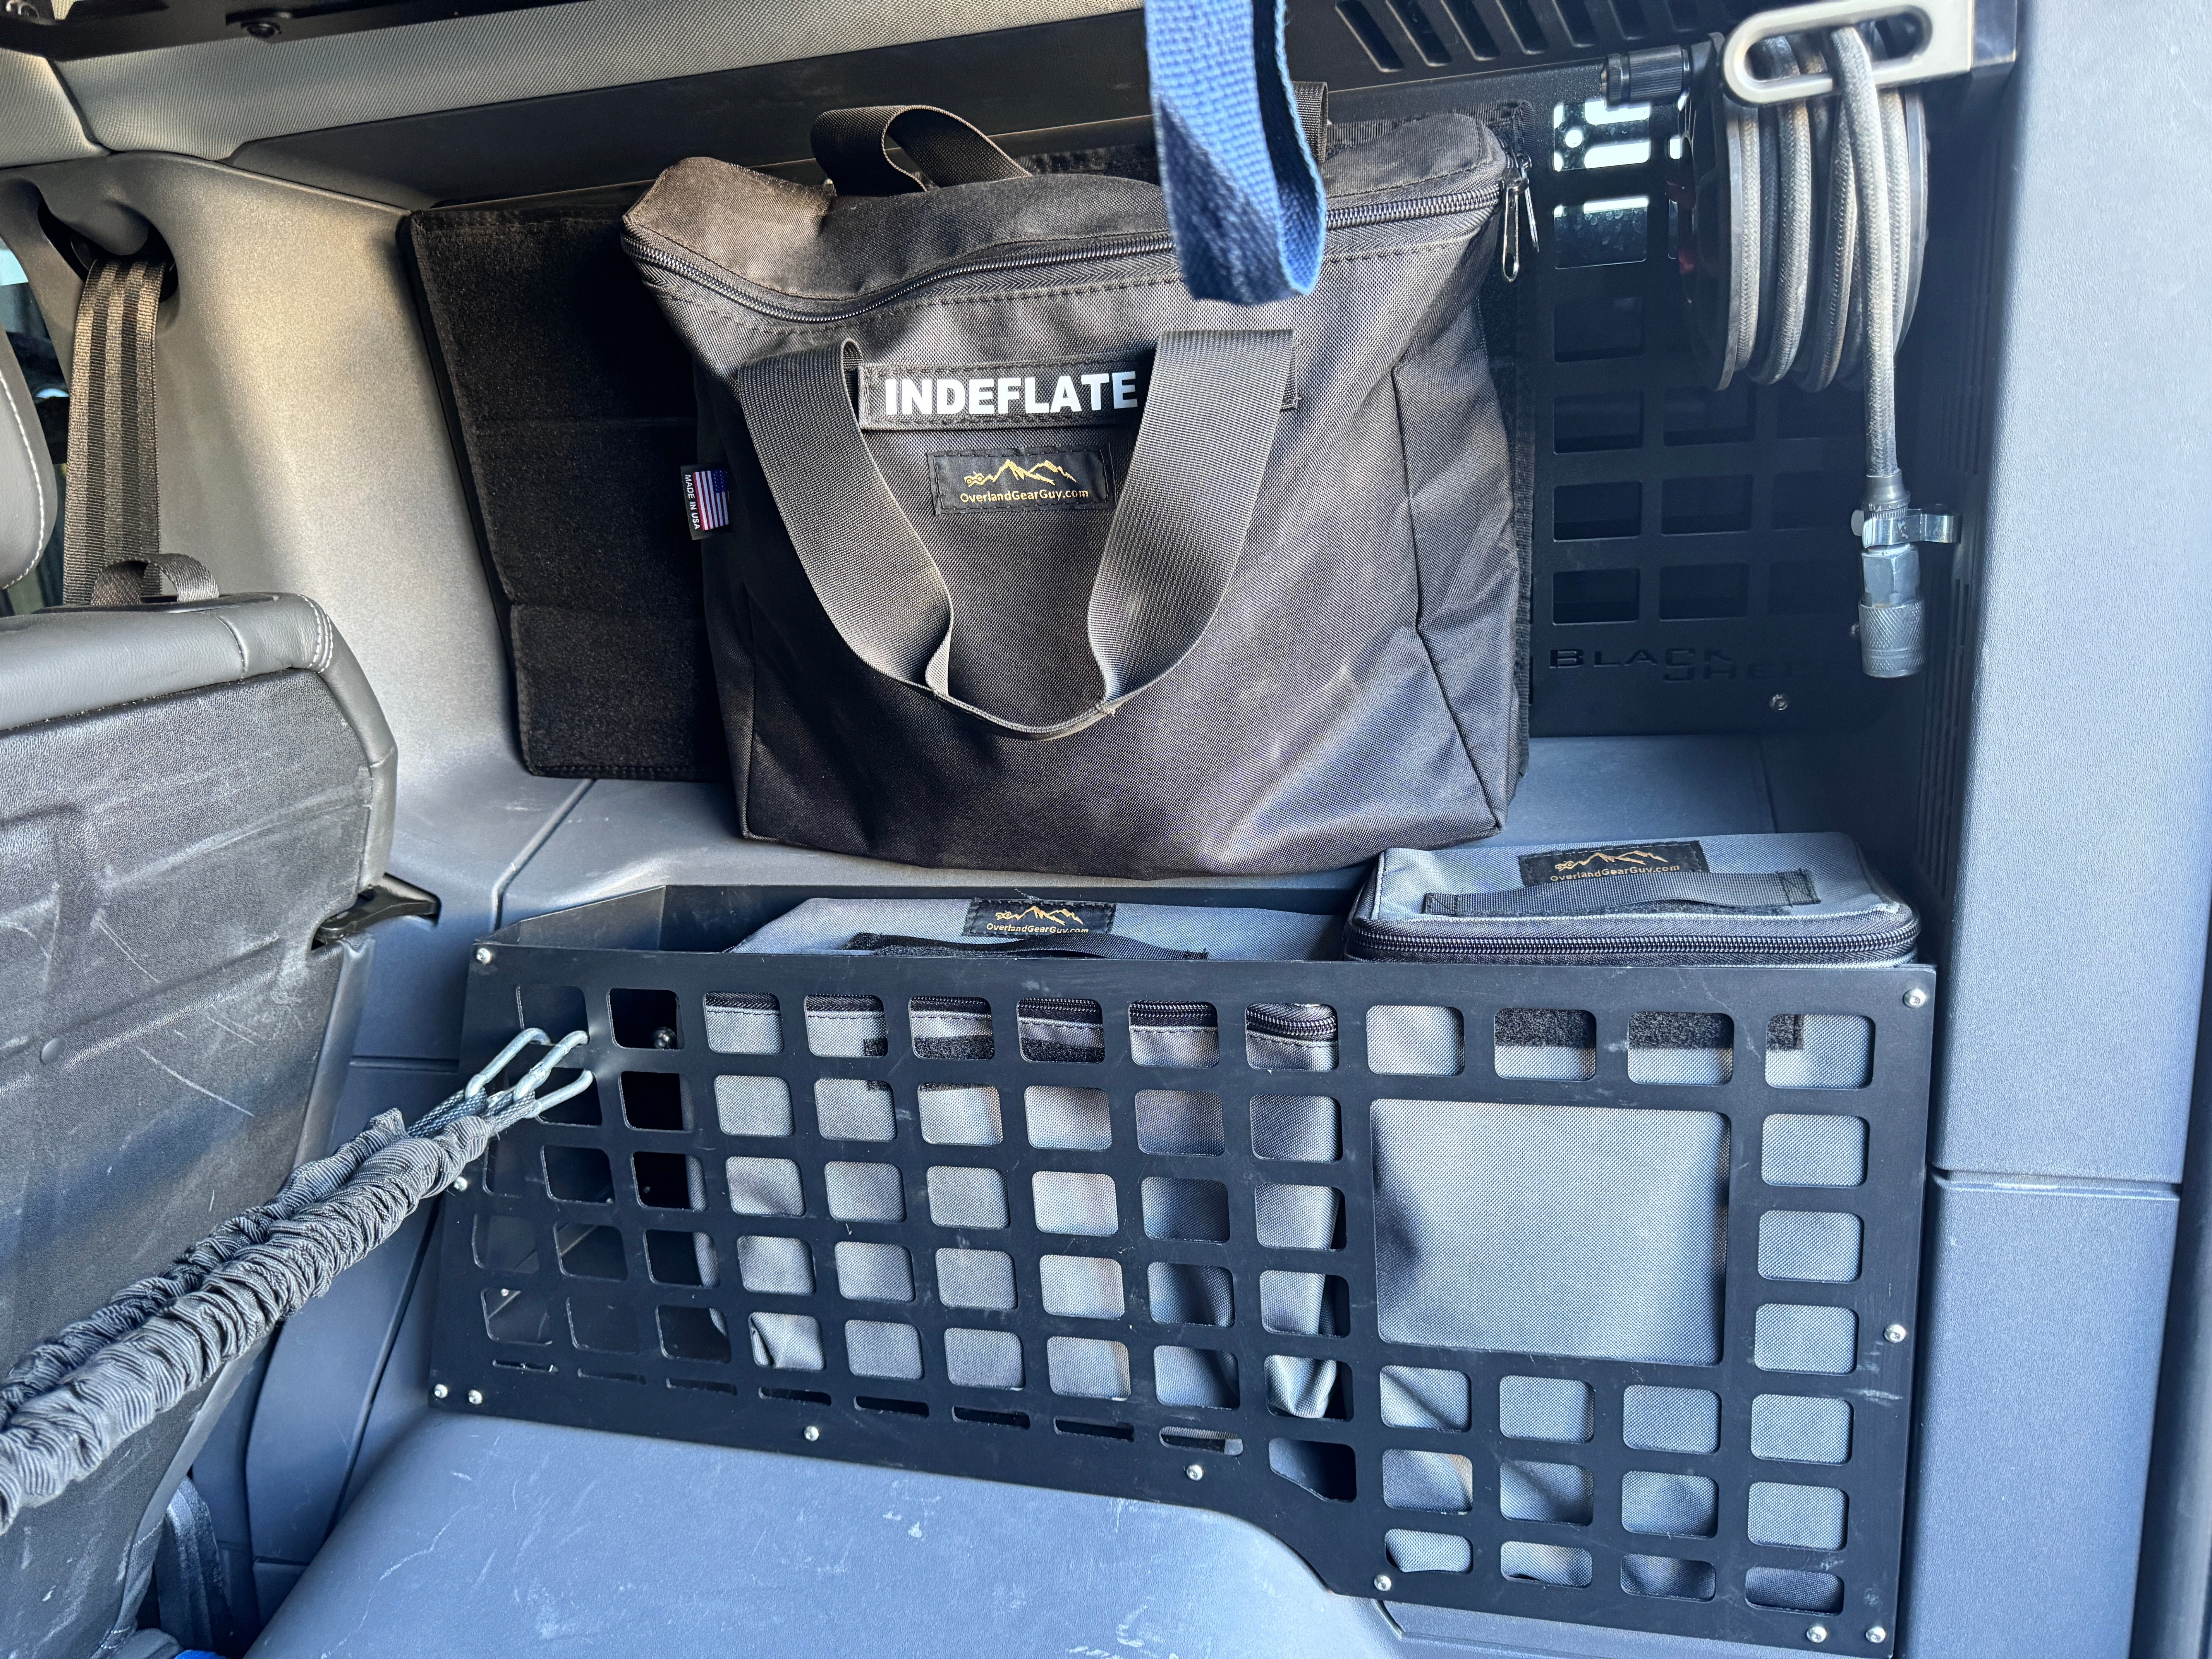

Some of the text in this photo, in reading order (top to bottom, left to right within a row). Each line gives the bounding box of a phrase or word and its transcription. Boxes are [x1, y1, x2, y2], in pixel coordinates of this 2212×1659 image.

[885, 371, 1138, 415] INDEFLATE
[685, 475, 701, 530] MADE IN USA
[960, 489, 1089, 503] OverlandGearGuy.com
[1549, 647, 1733, 668] BLACK
